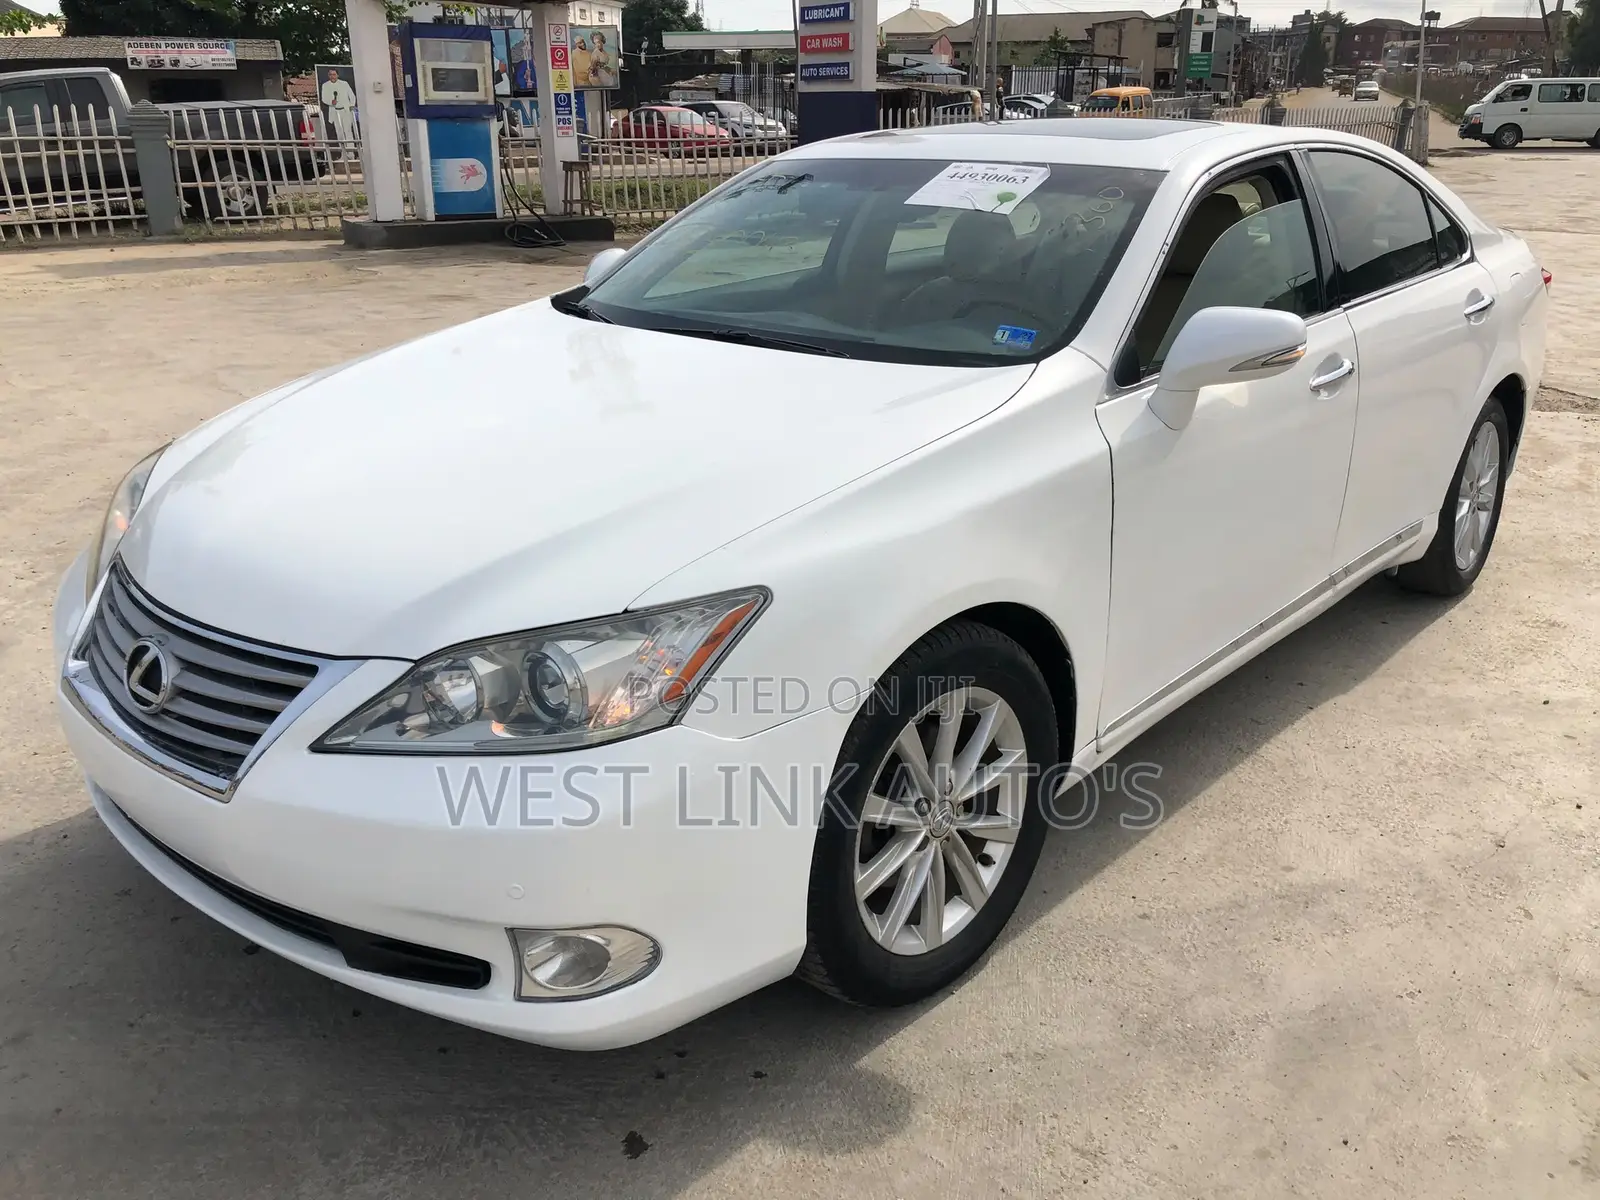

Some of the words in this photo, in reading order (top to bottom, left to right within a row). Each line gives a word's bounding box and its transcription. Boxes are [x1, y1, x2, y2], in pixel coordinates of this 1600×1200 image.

[804, 7, 844, 20] LUBRICANT
[806, 38, 820, 49] CAR
[821, 37, 843, 48] WASH
[802, 67, 818, 77] AUTO
[818, 66, 849, 76] SERVICES
[557, 117, 572, 126] POS
[947, 171, 1029, 184] 44930063
